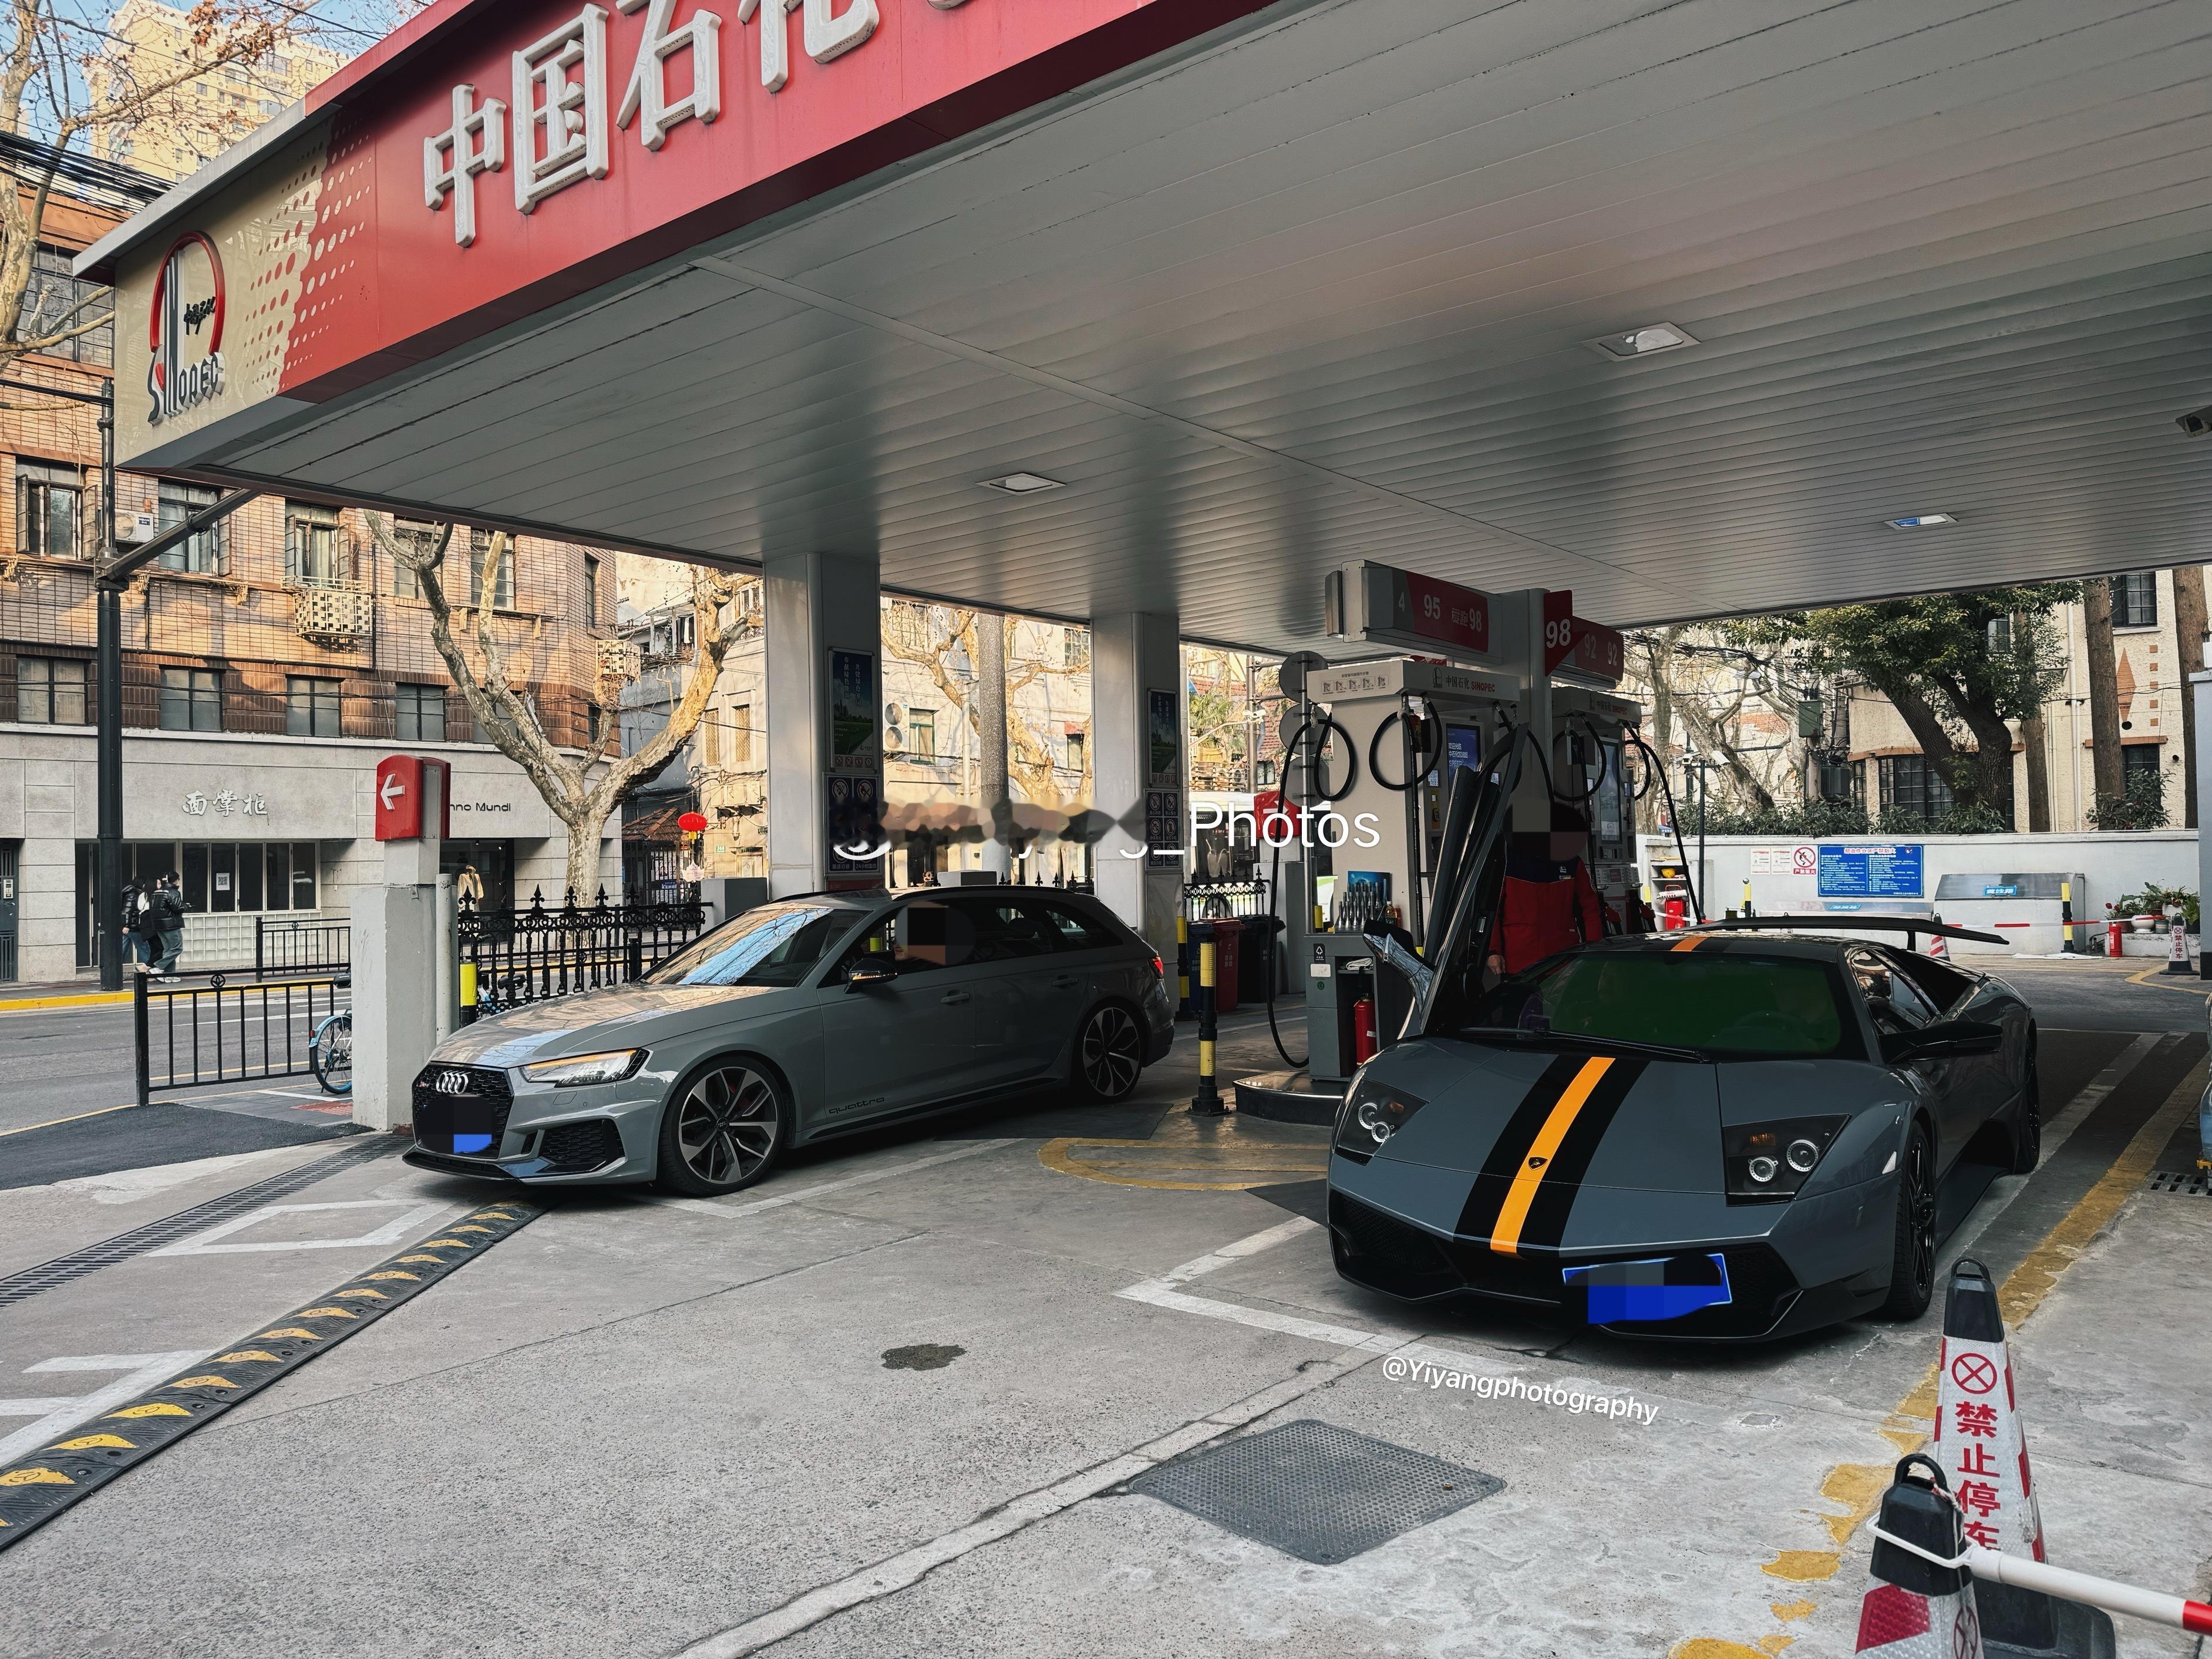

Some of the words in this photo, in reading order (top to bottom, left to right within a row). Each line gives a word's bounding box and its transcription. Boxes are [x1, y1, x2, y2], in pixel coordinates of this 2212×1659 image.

[1423, 594, 1441, 620] 95
[1546, 618, 1571, 648] 98
[1584, 634, 1597, 659] 92
[1607, 641, 1618, 667] 92
[1446, 675, 1470, 689] 中国石化
[1470, 681, 1496, 692] SINOPEC
[182, 789, 268, 817] 面掌柜
[476, 802, 511, 812] Mundi
[2174, 935, 2184, 959] 禁止停车
[829, 1096, 885, 1114] quattro
[1955, 1401, 2001, 1551] 禁止停车
